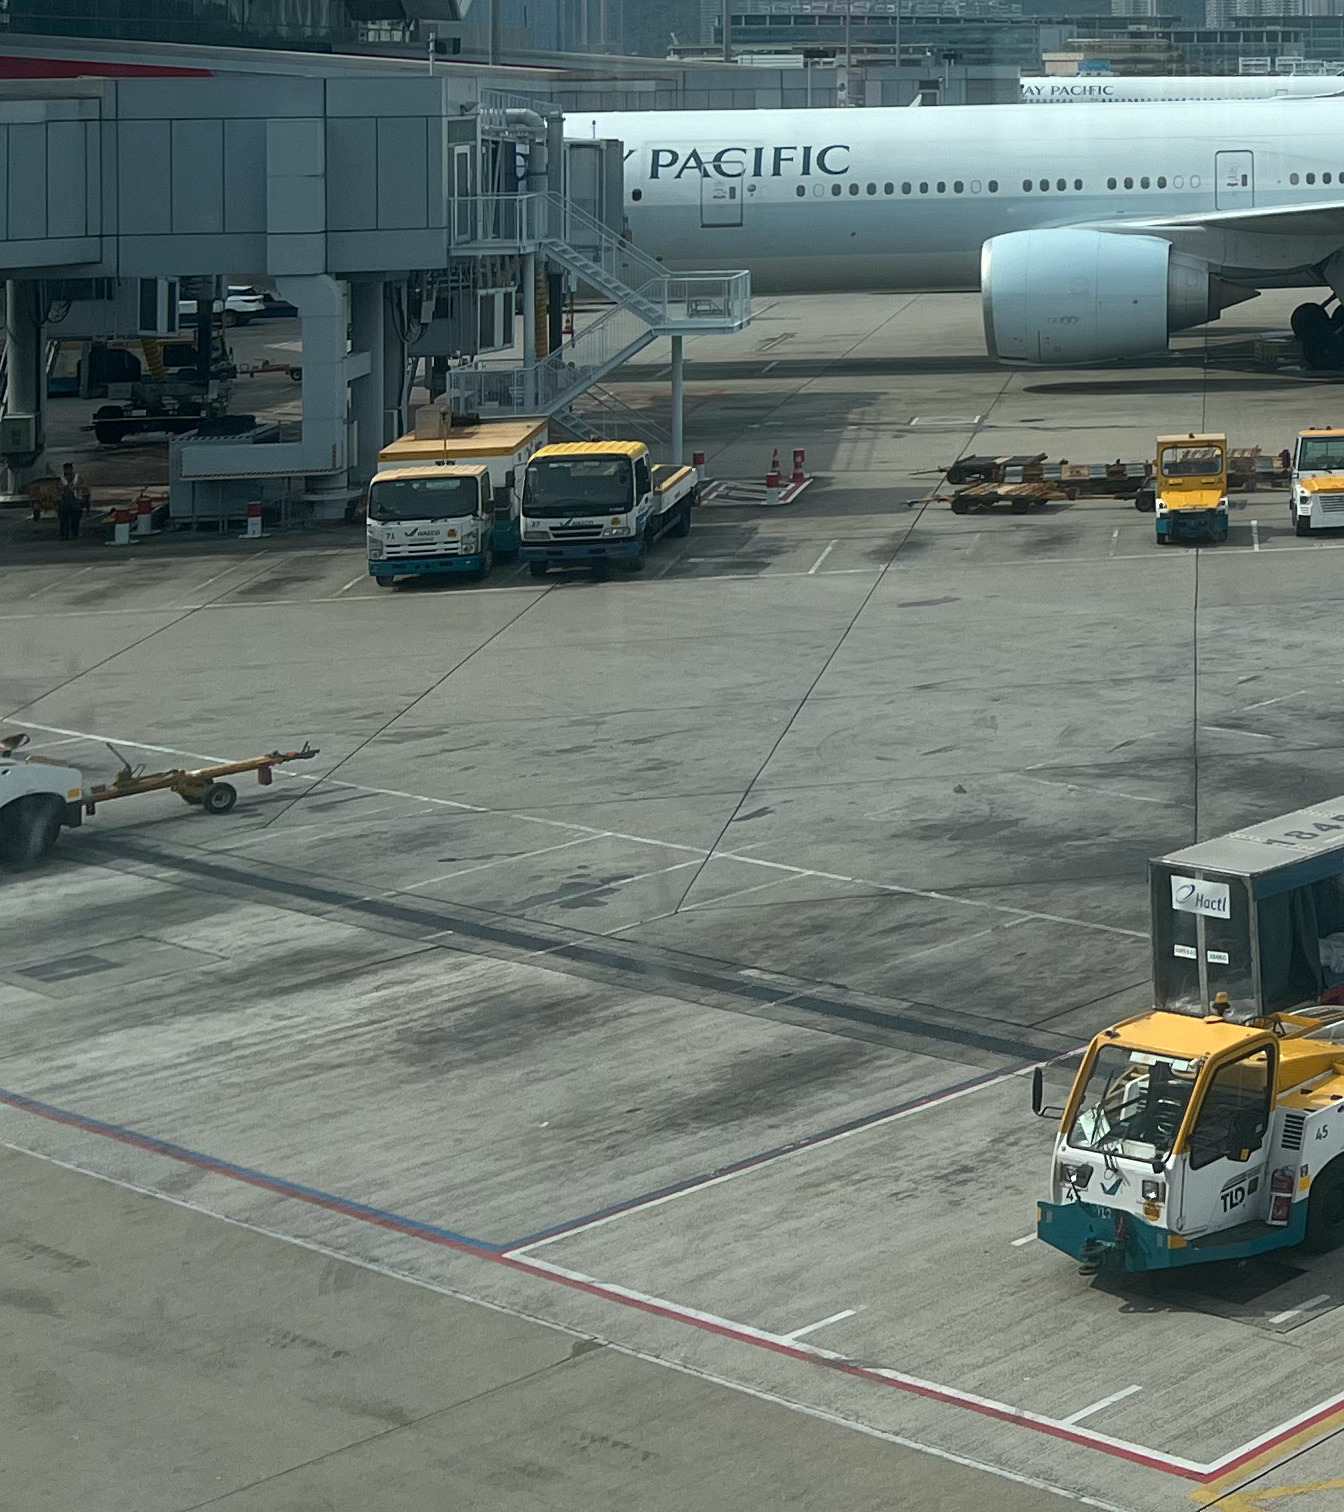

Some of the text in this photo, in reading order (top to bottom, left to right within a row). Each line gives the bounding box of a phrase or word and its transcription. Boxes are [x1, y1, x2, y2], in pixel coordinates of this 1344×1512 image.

[1051, 85, 1114, 96] PACIFIC
[649, 144, 850, 179] PACIFIC
[1195, 892, 1227, 912] Hactl
[1315, 1124, 1329, 1140] 45
[1220, 1186, 1246, 1213] TLD
